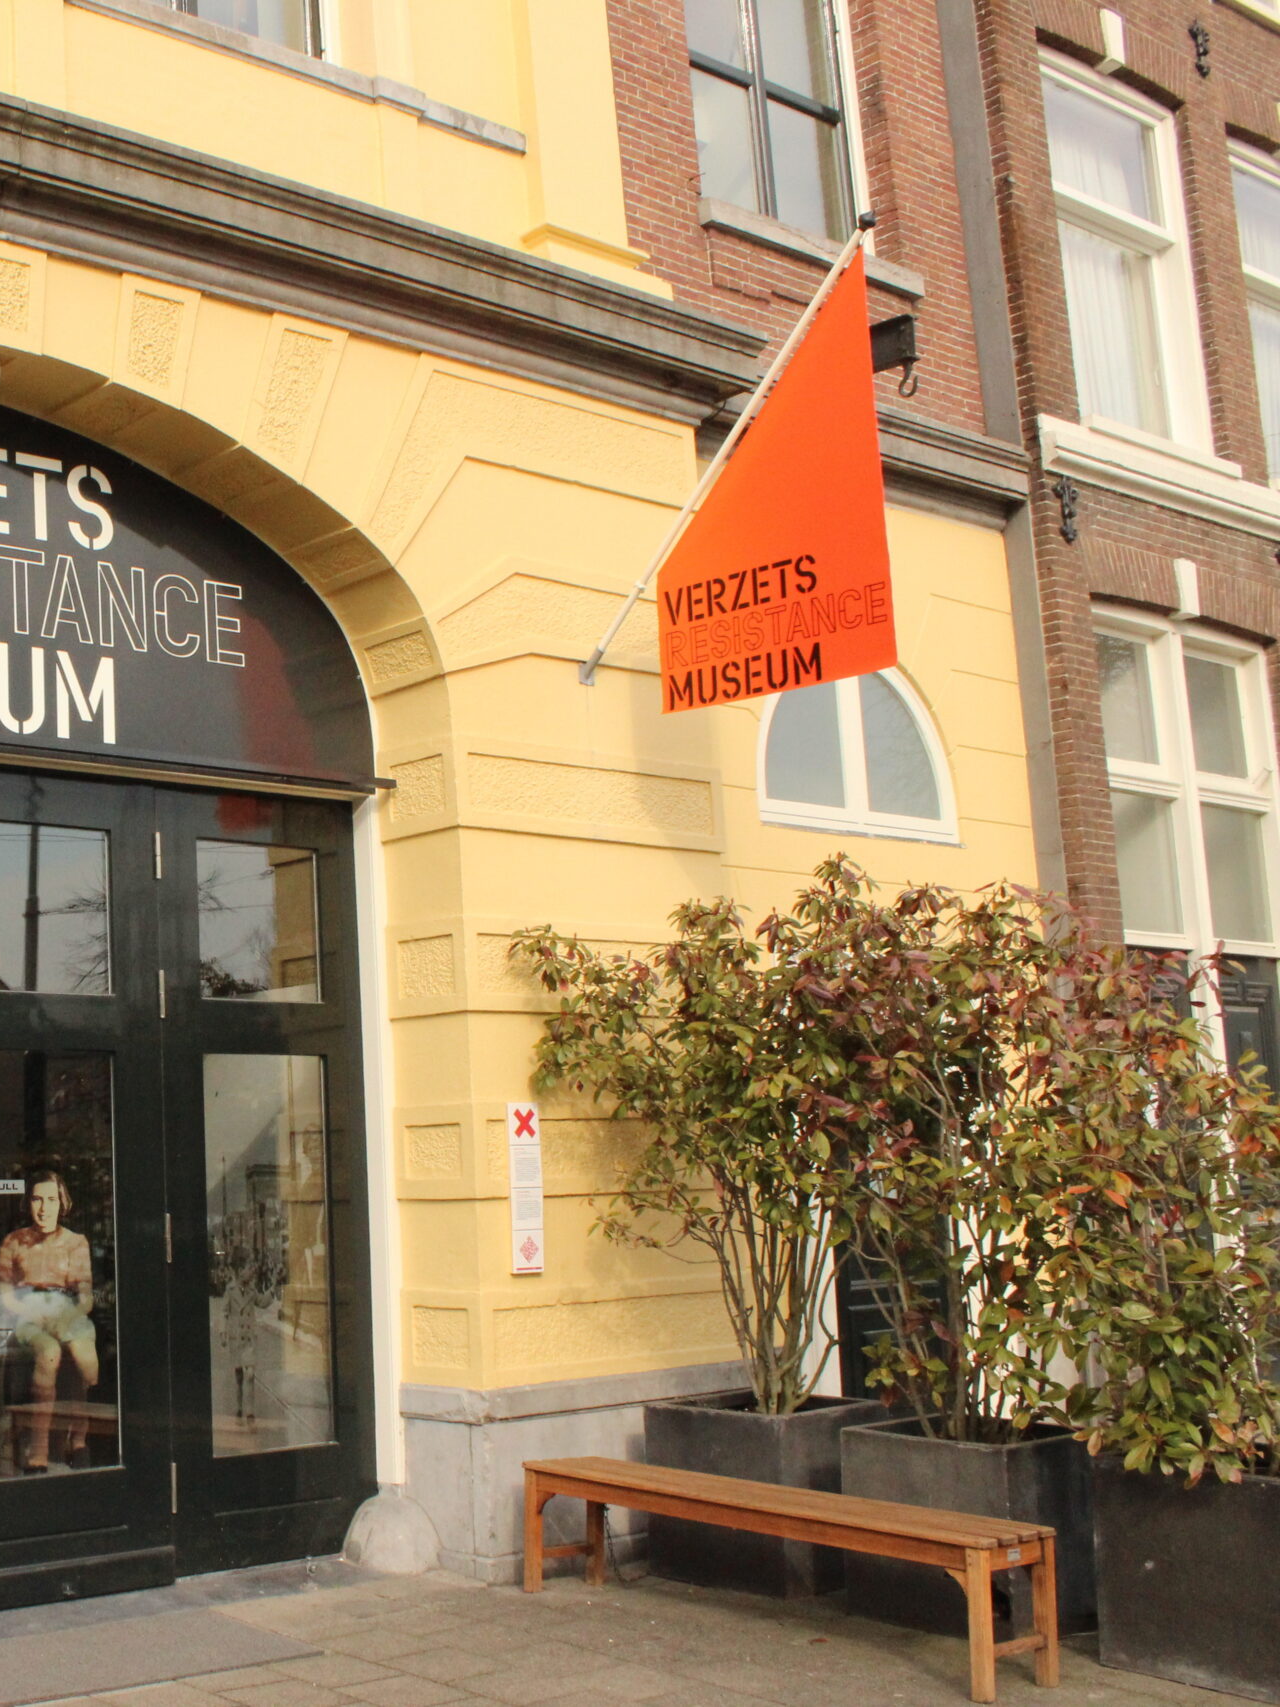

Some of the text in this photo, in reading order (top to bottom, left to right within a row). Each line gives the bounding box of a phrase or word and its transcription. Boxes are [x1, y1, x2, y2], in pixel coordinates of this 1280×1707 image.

[664, 554, 817, 626] VERZETS
[665, 581, 888, 670] RESISTANCE
[668, 642, 822, 711] MUSEUM
